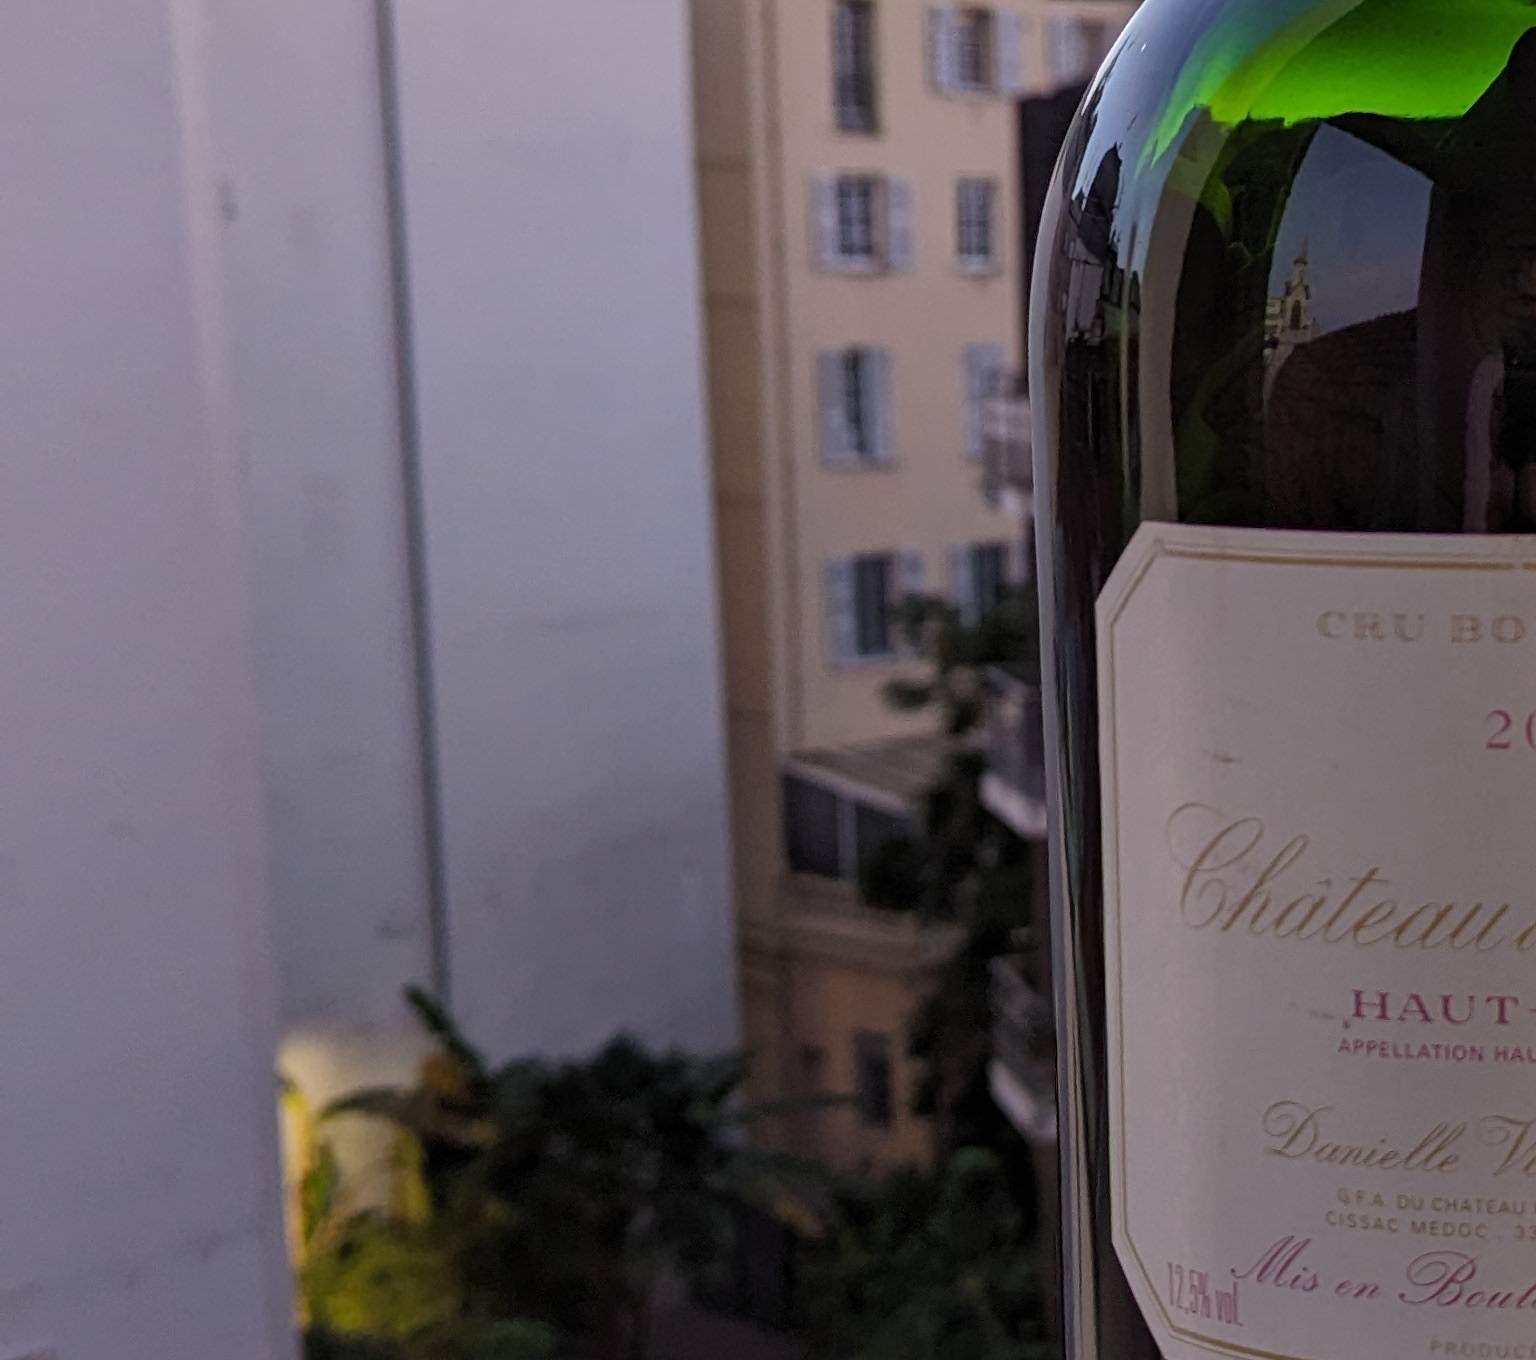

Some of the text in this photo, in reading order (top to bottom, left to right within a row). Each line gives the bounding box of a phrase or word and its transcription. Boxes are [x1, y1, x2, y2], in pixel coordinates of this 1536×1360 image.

[1315, 610, 1425, 641] CRU
[1166, 802, 1514, 952] Château
[1338, 1038, 1484, 1062] APPELLATION
[1263, 1099, 1468, 1170] Danielle
[1396, 1193, 1423, 1211] DU
[1325, 1210, 1399, 1233] CISSAC
[1230, 1234, 1320, 1292] Mis
[1333, 1279, 1381, 1299] en
